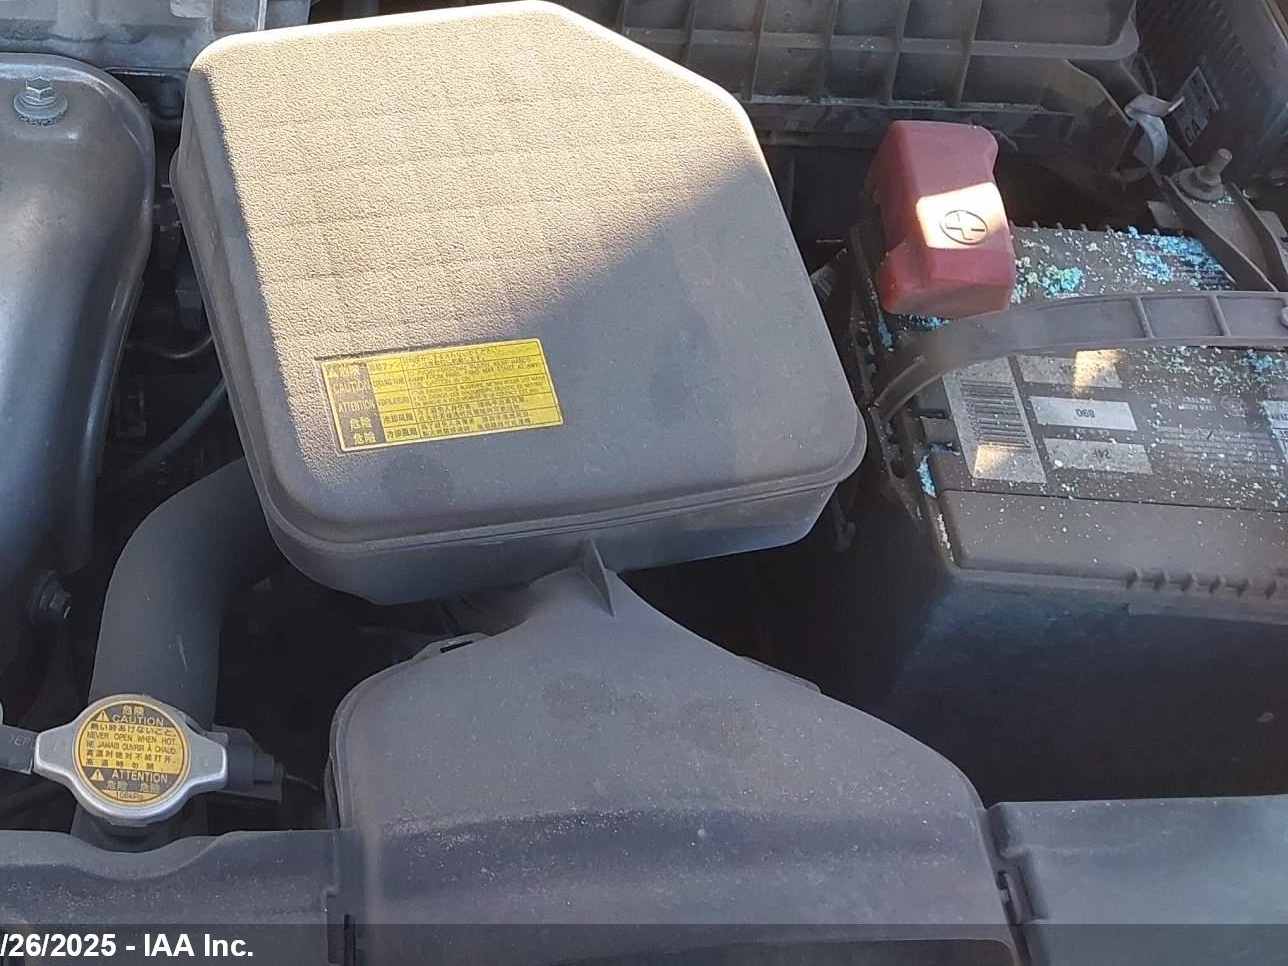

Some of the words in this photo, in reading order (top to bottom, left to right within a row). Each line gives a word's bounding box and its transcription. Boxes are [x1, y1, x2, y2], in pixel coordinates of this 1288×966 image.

[332, 379, 371, 395] CAUTION
[336, 398, 375, 413] ATTENTION
[1075, 408, 1095, 419] 890
[113, 715, 163, 726] CAUTION
[114, 734, 132, 742] OPEN
[98, 742, 119, 750] JAMAIS
[112, 769, 167, 783] ATTENTION
